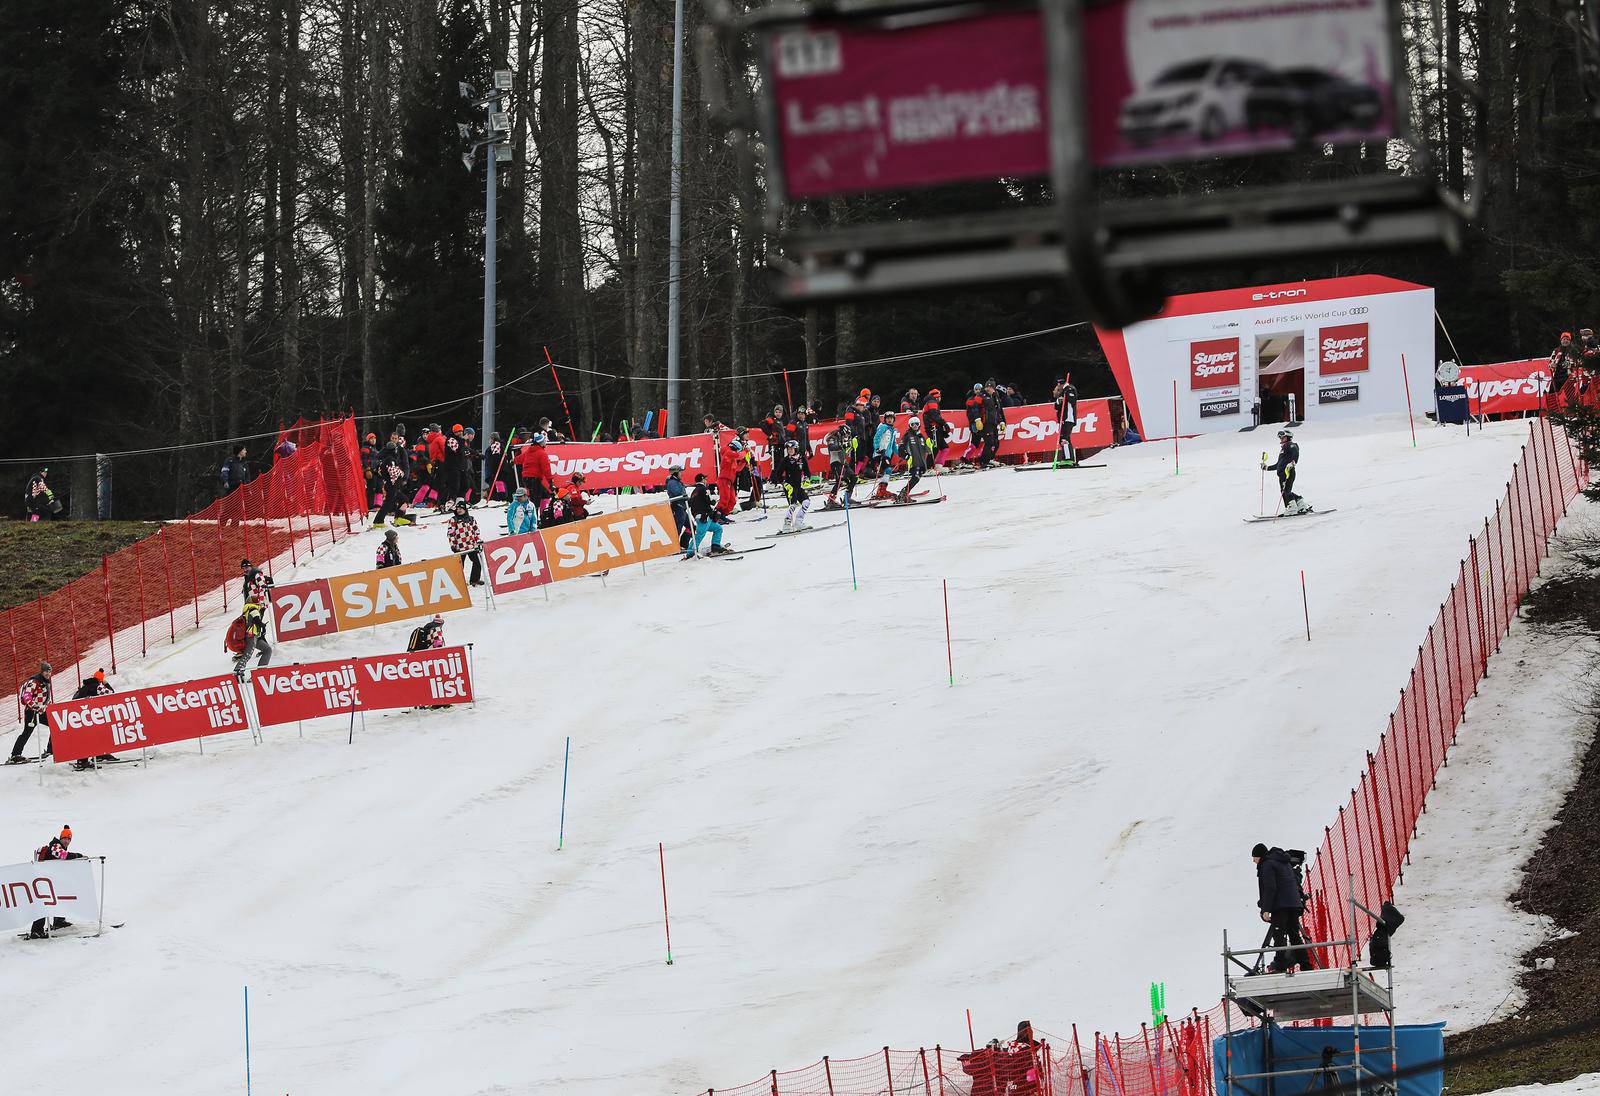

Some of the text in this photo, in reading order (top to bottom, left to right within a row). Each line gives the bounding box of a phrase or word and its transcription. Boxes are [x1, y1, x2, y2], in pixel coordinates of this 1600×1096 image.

[787, 82, 1038, 136] Last minute
[1252, 288, 1306, 301] e-tron
[1255, 317, 1274, 326] Audi
[1290, 314, 1302, 322] Ski
[1305, 311, 1330, 320] World
[1331, 310, 1347, 318] Cup
[1321, 337, 1366, 350] Super
[1323, 347, 1364, 363] Sport
[1193, 351, 1237, 364] Super
[1194, 362, 1235, 377] Sport
[1321, 388, 1357, 398] LONGINES
[1202, 401, 1238, 411] LONGINES
[548, 448, 703, 476] SuperSport
[490, 514, 672, 585] 24 SATA
[276, 567, 462, 633] 24 SATA
[258, 664, 357, 696] Večernji
[365, 653, 463, 682] Večernji
[146, 680, 237, 714] Večernji
[323, 686, 362, 710] list
[429, 676, 466, 699] list
[52, 697, 141, 731] Večernji
[207, 703, 243, 728] list
[111, 721, 147, 746] list
[0, 877, 77, 908] ing_
